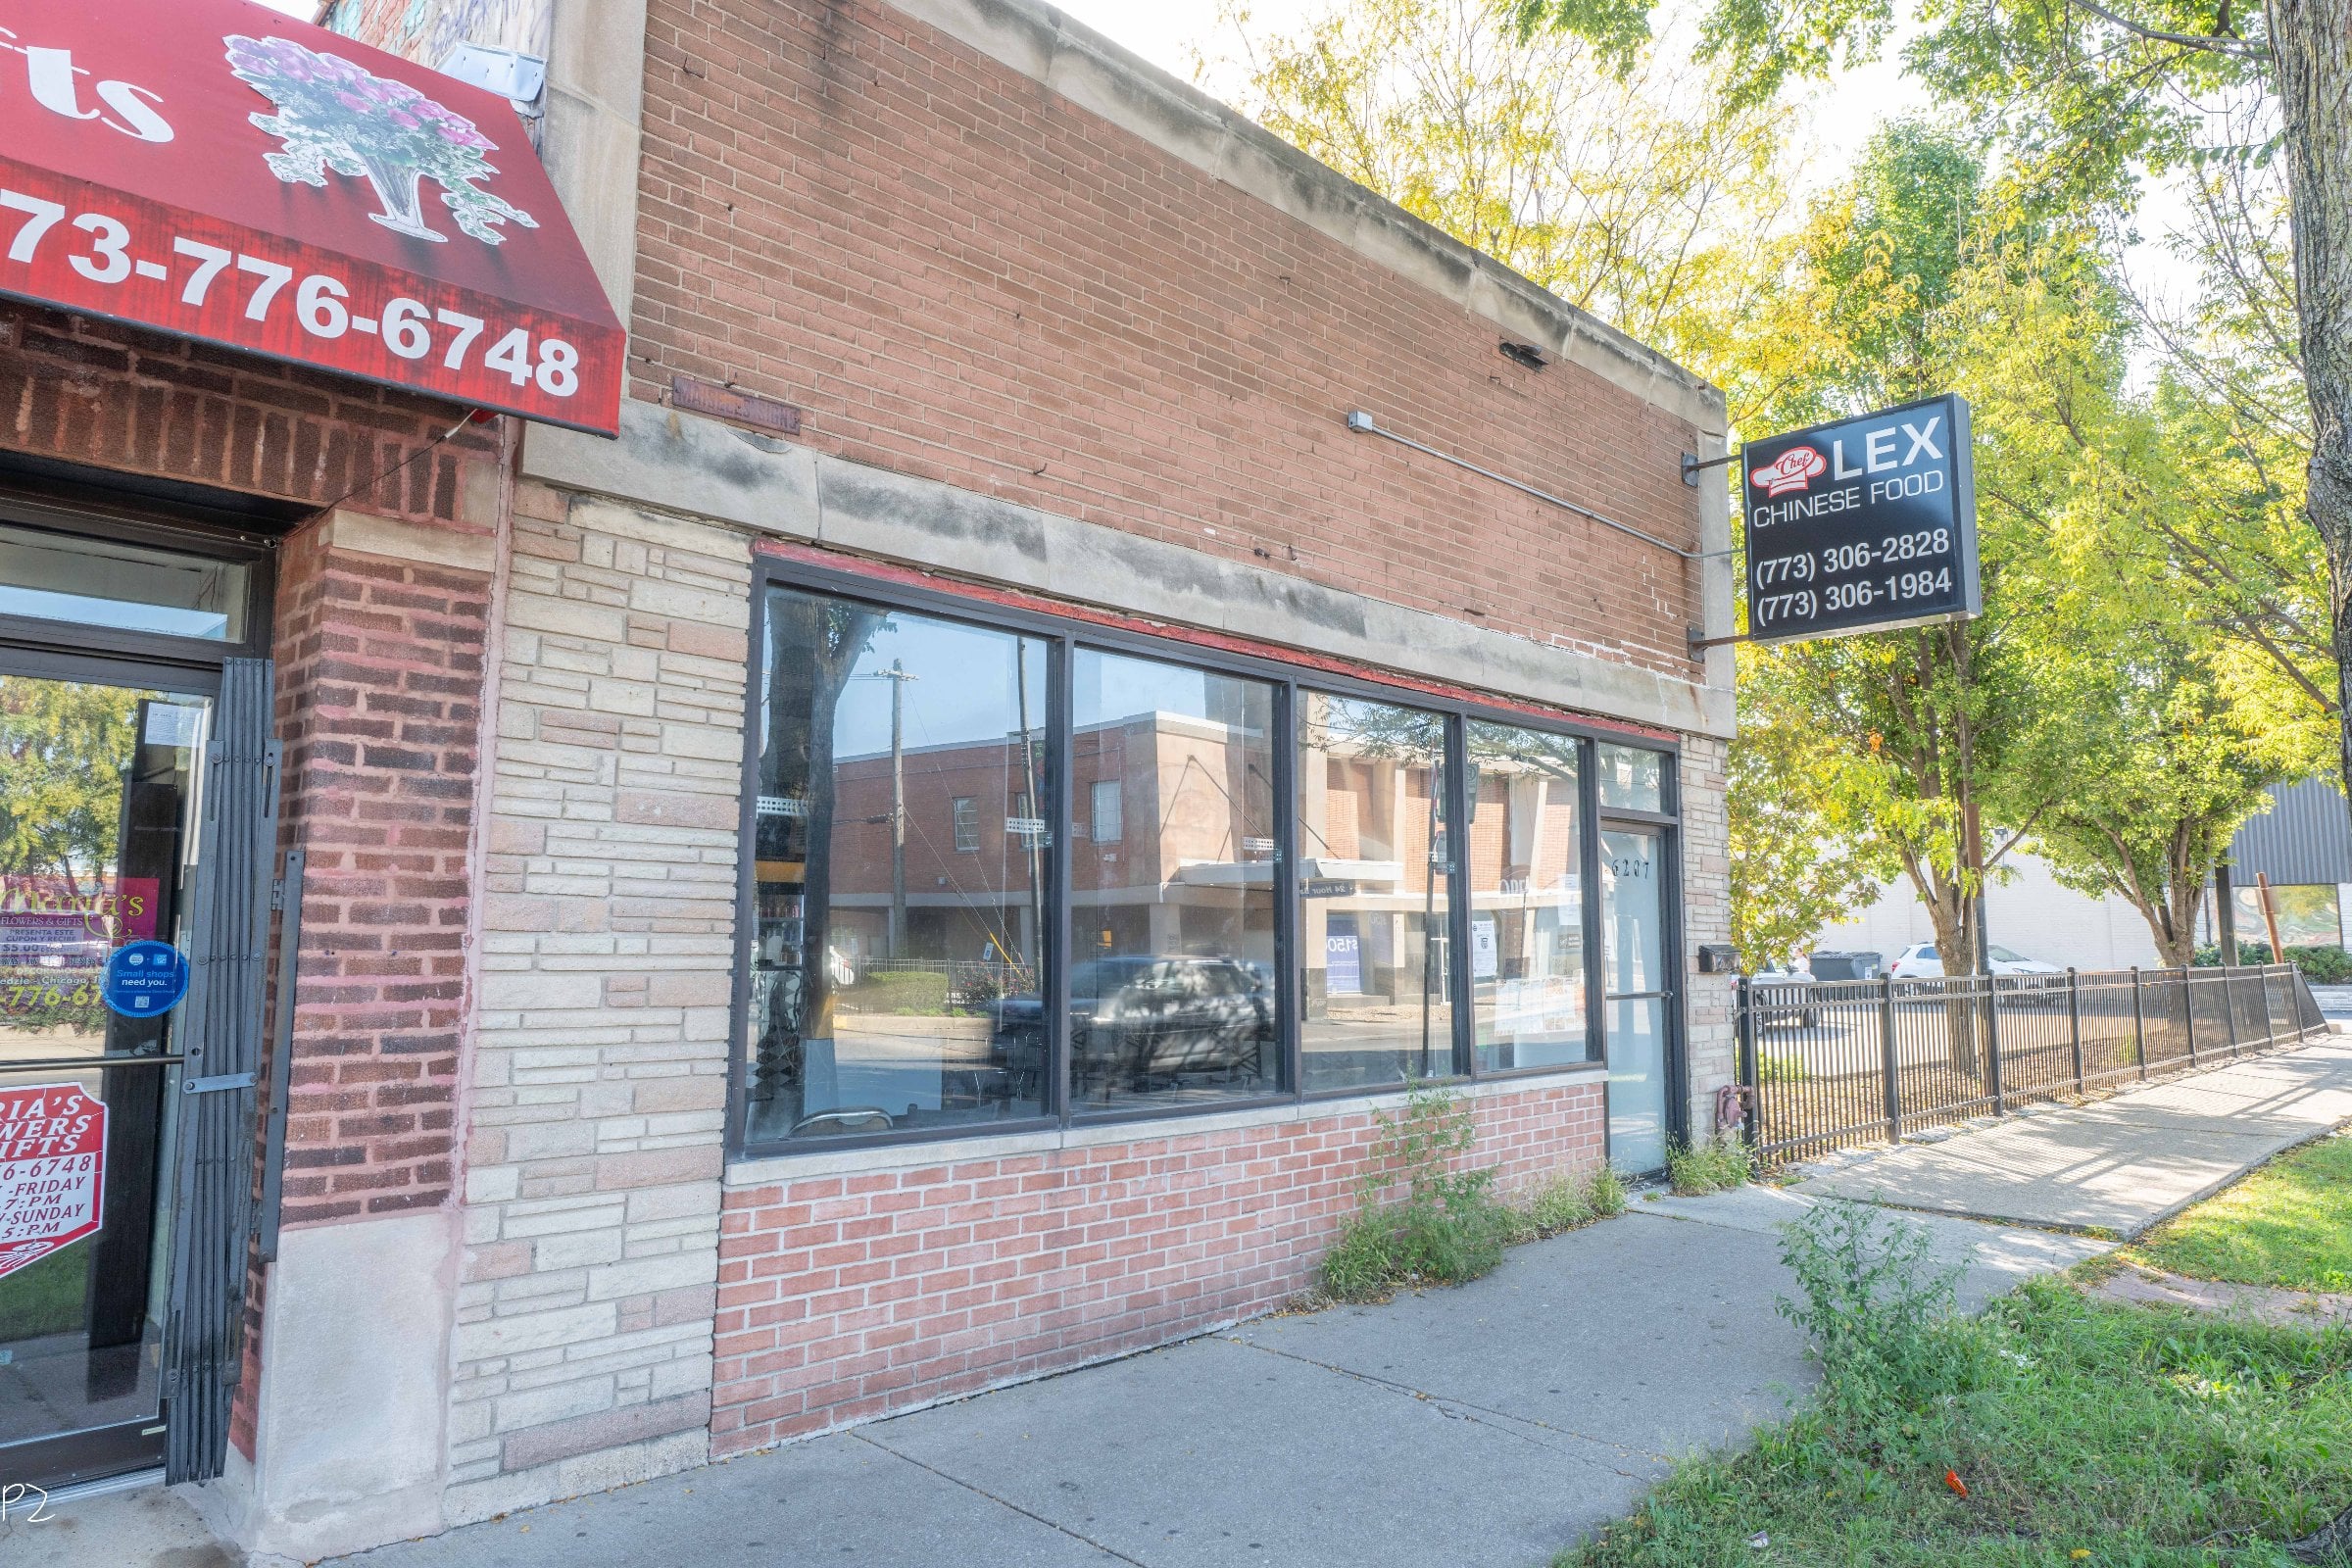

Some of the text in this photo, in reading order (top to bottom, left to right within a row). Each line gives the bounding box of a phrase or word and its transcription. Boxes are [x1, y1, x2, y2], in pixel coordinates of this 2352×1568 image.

[0, 188, 579, 398] 73-776-6748
[1776, 452, 1810, 477] Chef
[1834, 416, 1943, 481] LEX
[1753, 469, 1943, 528] CHINESE FOOD
[1756, 527, 1950, 590] (773) 306-2828
[1757, 566, 1952, 626] (773) 306-1984
[1, 916, 44, 926] FLOWERS
[56, 917, 83, 926] GIFTS
[41, 976, 89, 987] Chicago,
[118, 969, 174, 979] Small shops
[147, 979, 168, 988] you.
